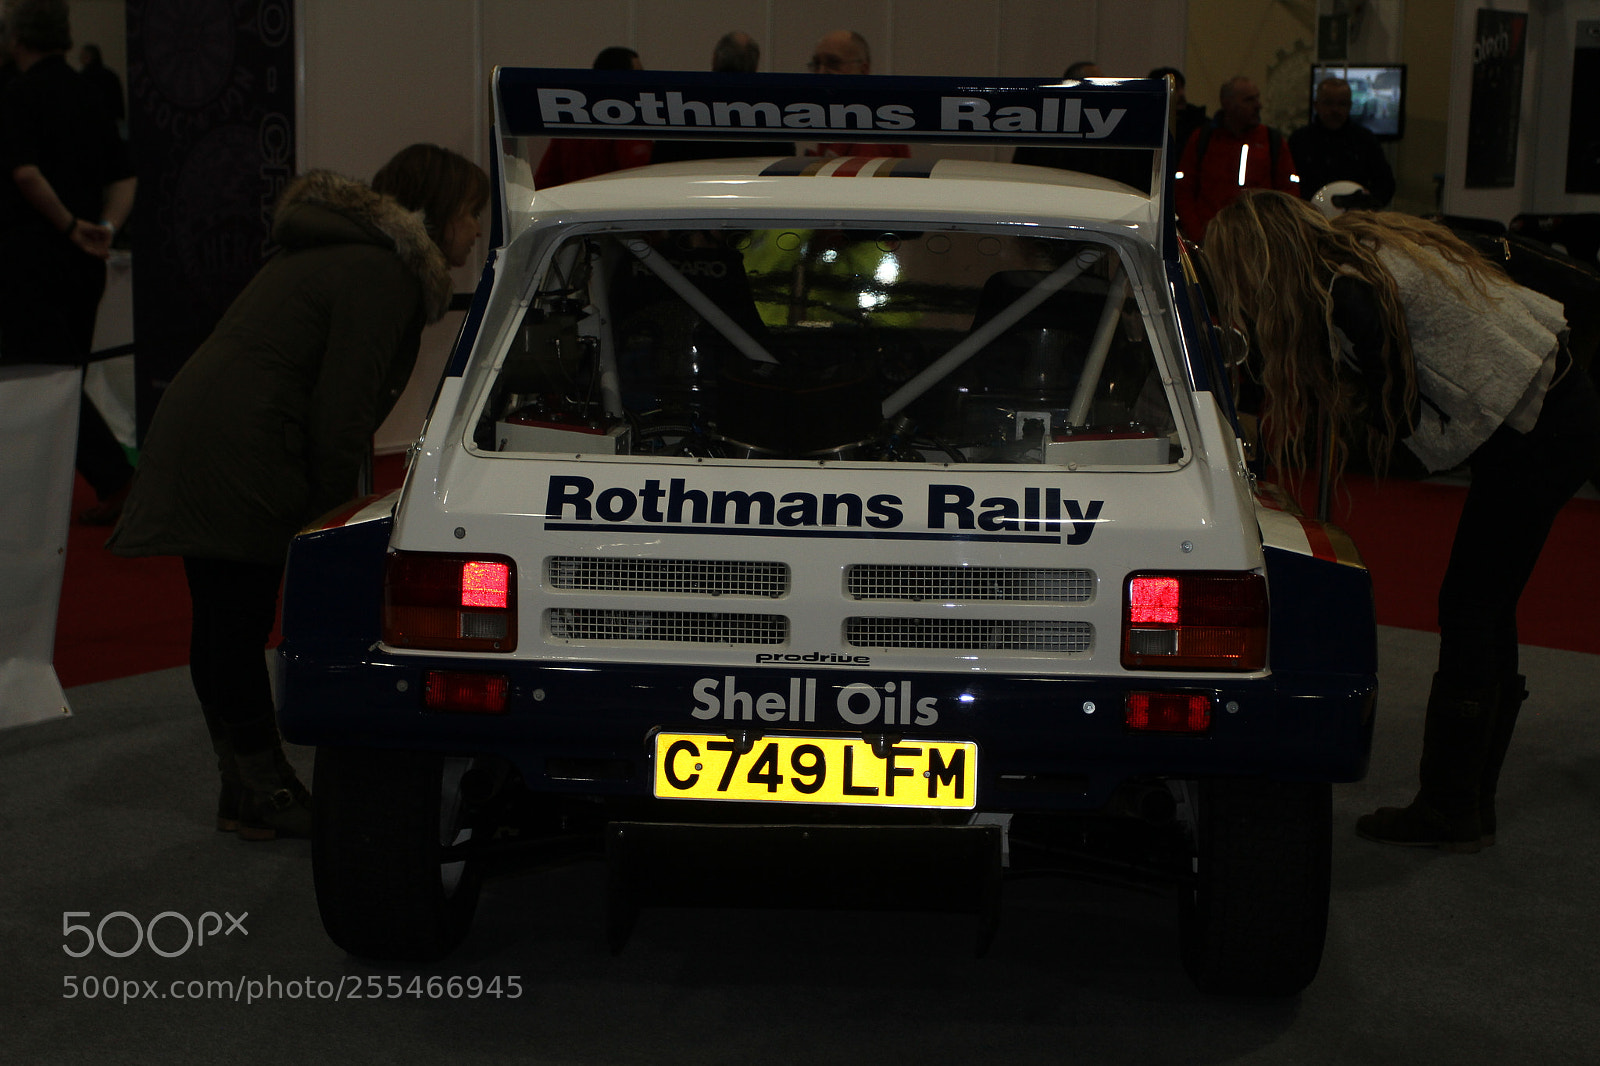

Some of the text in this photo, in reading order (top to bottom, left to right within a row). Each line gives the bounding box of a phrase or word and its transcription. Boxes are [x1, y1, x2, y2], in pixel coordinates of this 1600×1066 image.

[536, 87, 1128, 139] Rothmans Rally
[545, 475, 1105, 546] Rothmans Rally
[756, 651, 870, 664] prodrive
[691, 675, 940, 727] Shell Oils
[664, 740, 966, 799] C749 LFM
